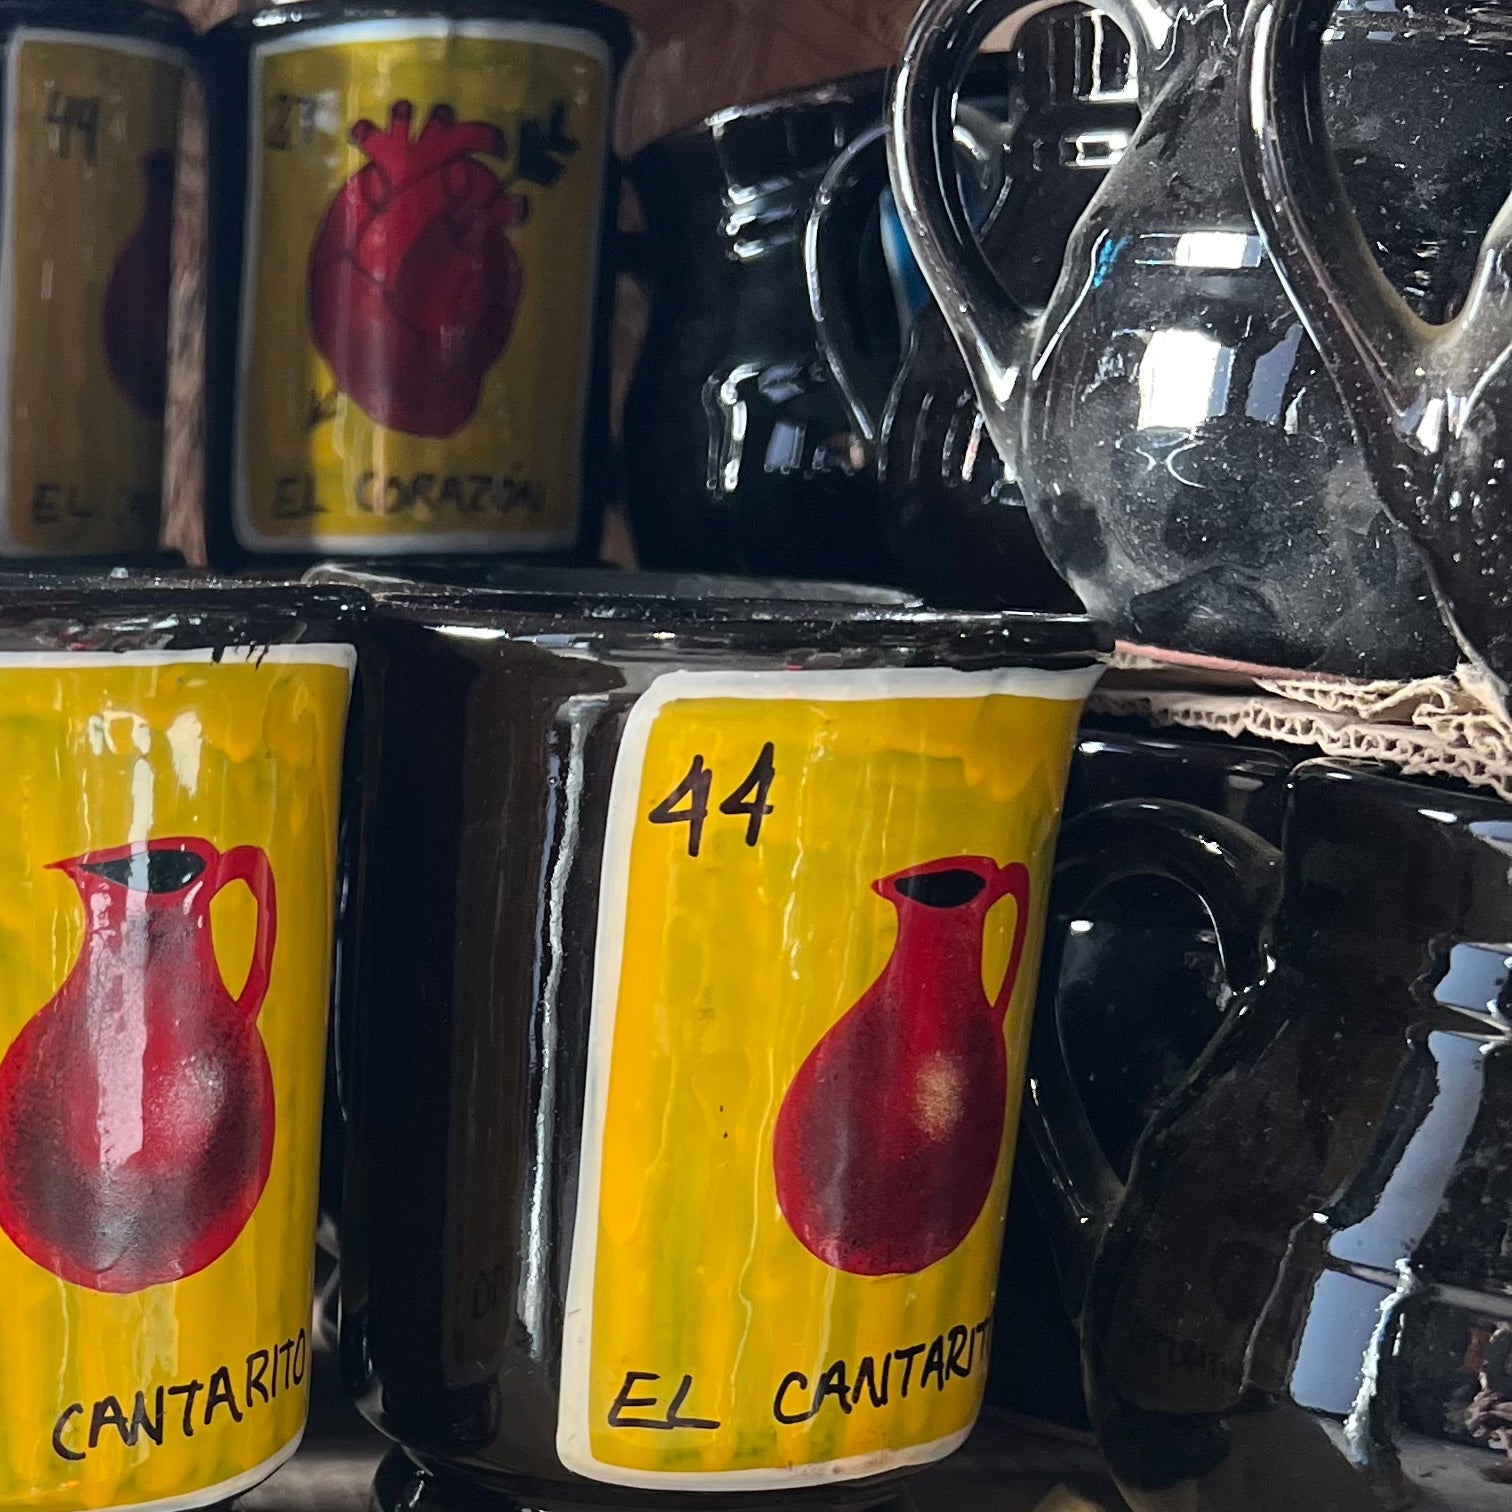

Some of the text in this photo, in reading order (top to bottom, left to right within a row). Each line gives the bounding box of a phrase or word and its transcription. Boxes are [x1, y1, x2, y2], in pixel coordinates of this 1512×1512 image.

[274, 477, 331, 518] EL
[648, 742, 775, 858] 44
[51, 1327, 307, 1461] CANTARITO
[607, 1317, 991, 1429] EL CANTARIT
